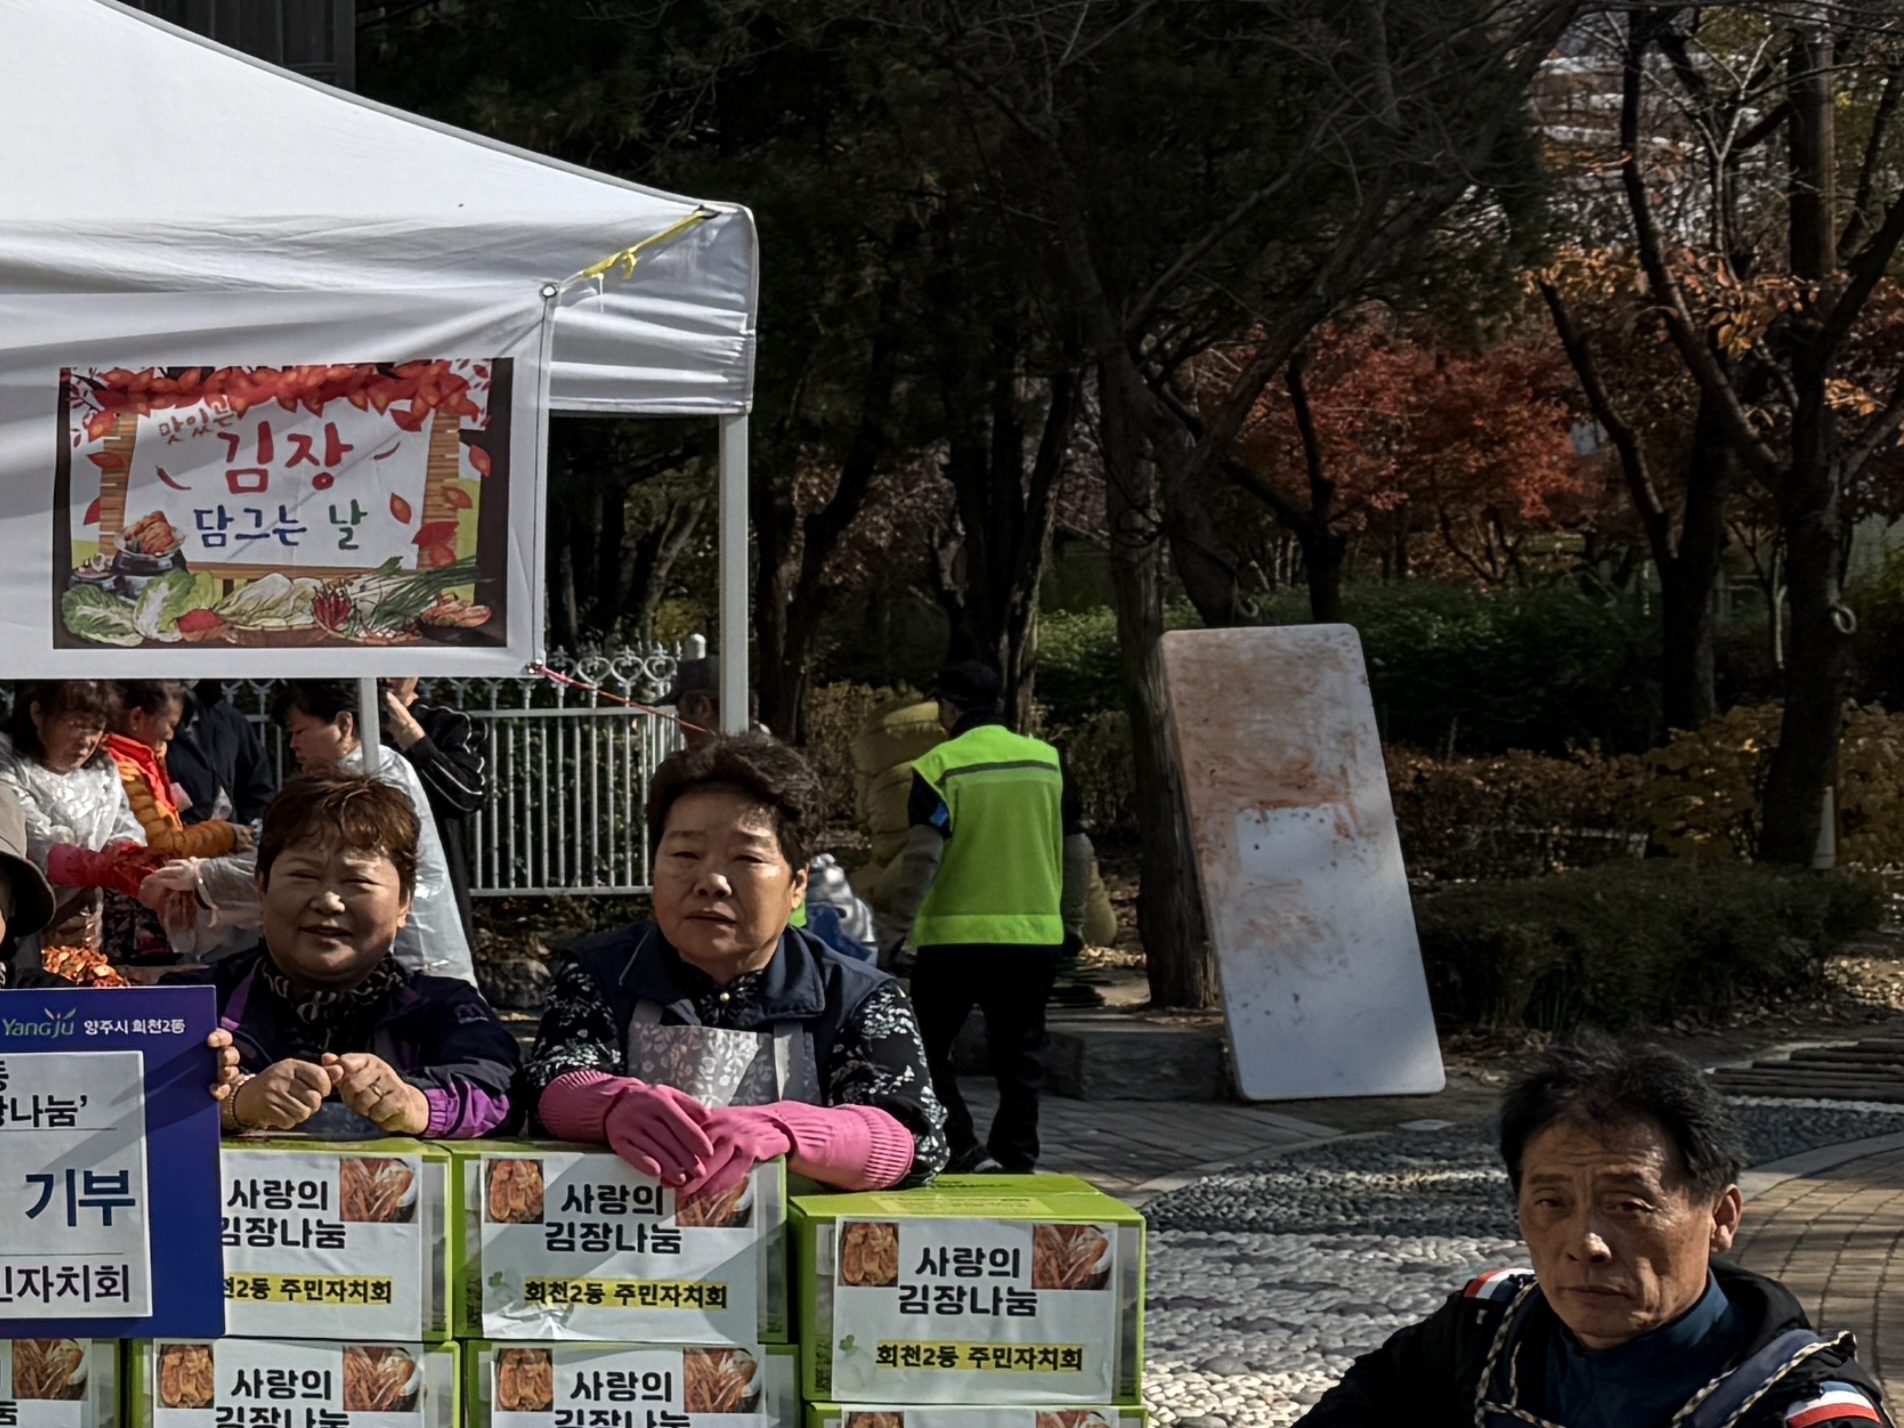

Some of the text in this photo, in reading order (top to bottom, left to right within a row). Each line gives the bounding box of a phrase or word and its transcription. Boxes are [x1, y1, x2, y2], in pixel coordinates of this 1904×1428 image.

[158, 393, 236, 445] 맛있는
[217, 420, 354, 494] 김장
[193, 498, 369, 550] 담그는 날
[83, 1018, 186, 1036] 양주시 회천2동
[26, 1169, 135, 1226] 기부
[228, 1178, 328, 1212] 사랑의
[561, 1184, 664, 1215] 사랑의
[220, 1216, 346, 1249] 김장나눔
[545, 1220, 681, 1254] 김장나눔
[916, 1247, 1020, 1278] 사랑의
[281, 1278, 392, 1303] 주민자치회
[524, 1281, 727, 1305] 회천2동 주민자치회
[899, 1283, 1037, 1316] 김장나눔
[876, 1345, 1082, 1371] 회천2동 주민자치회
[231, 1369, 331, 1400] 사랑의
[570, 1371, 671, 1402] 사랑의
